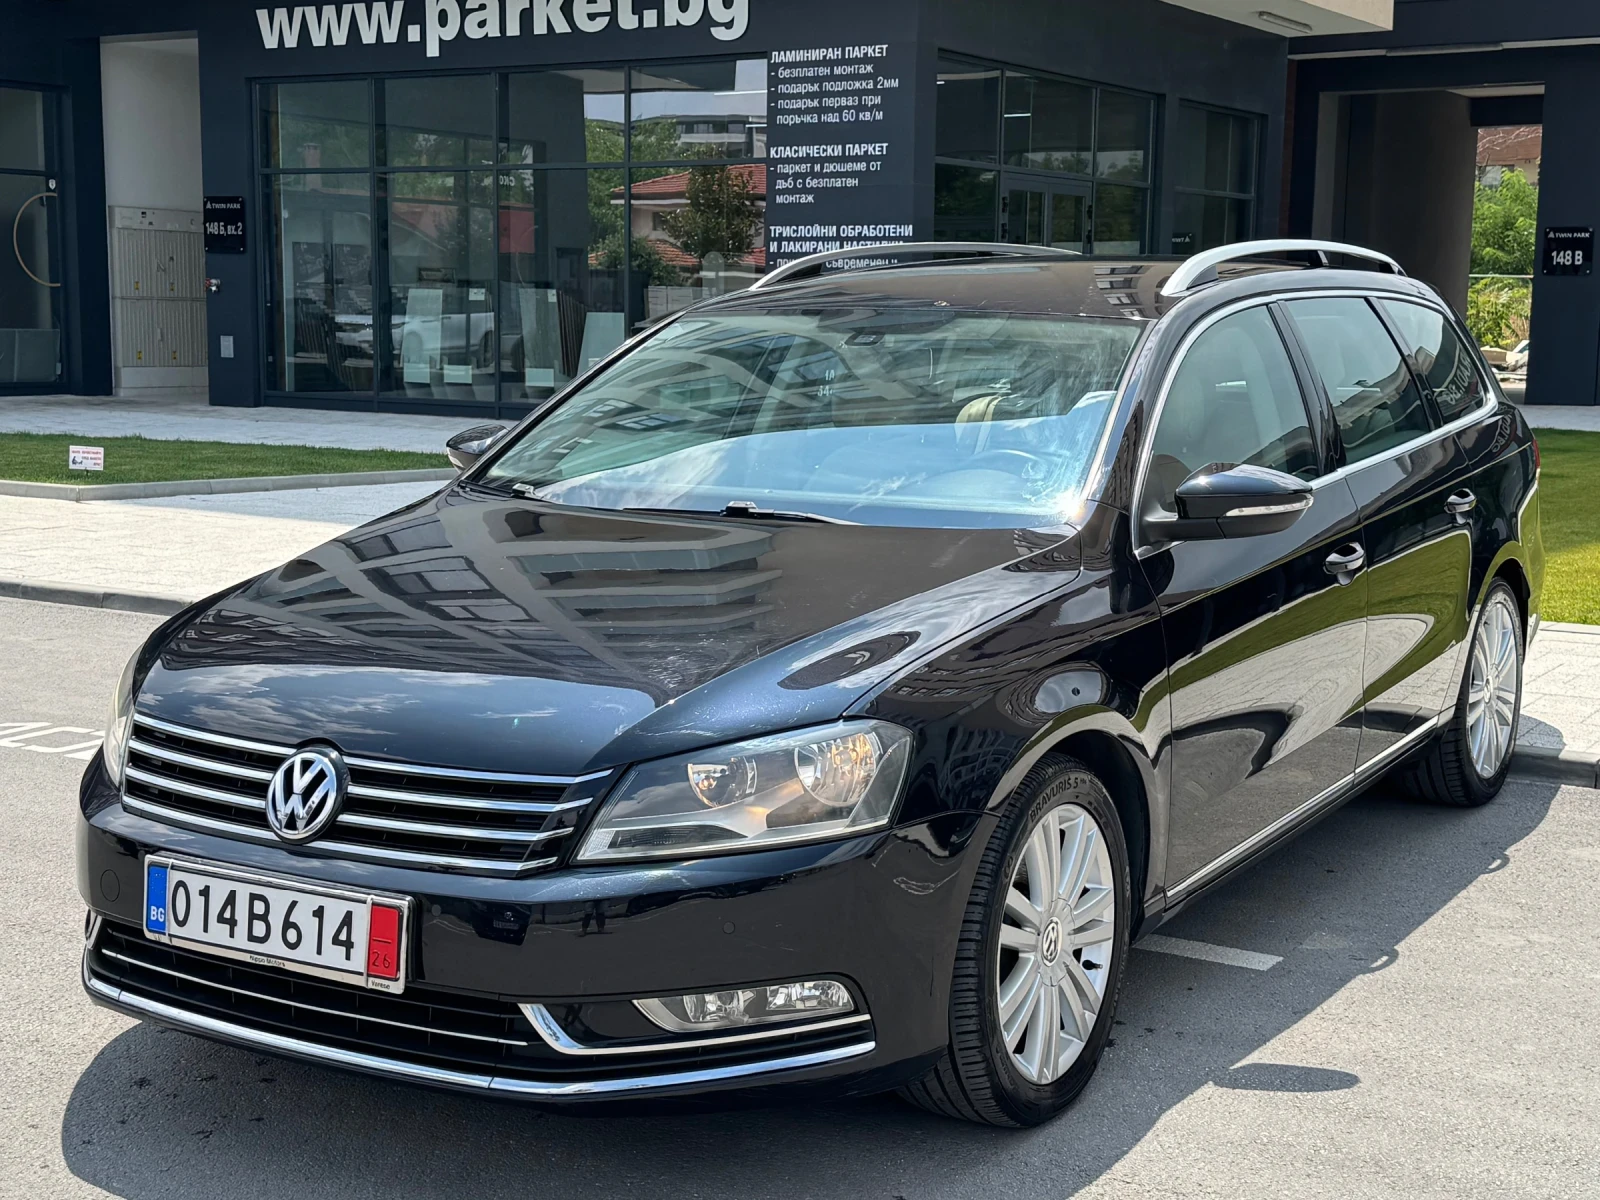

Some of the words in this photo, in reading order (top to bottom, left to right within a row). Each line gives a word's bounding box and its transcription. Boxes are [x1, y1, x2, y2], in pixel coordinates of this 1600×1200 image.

[255, 0, 750, 57] www.parket.bg
[771, 47, 842, 63] ЛАМИНИРАН
[845, 44, 888, 58] ПАРКЕТ
[778, 66, 830, 78] безплатен
[834, 63, 874, 75] монтаж
[778, 82, 820, 94] подарък
[822, 78, 874, 92] подложка
[877, 76, 899, 89] 2мм
[778, 98, 820, 110] подарък
[822, 96, 859, 108] перваз
[862, 95, 881, 106] при
[776, 114, 818, 126] поръчка
[821, 112, 840, 124] над
[842, 110, 856, 122] 60
[859, 109, 884, 122] кв/м
[770, 145, 842, 159] КЛАСИЧЕСКИ
[845, 142, 888, 156] ПАРКЕТ
[777, 162, 811, 174] паркет
[814, 163, 821, 172] и
[823, 162, 867, 173] дюшеме
[870, 161, 882, 171] от
[776, 177, 794, 189] дъб
[796, 179, 803, 188] с
[805, 176, 859, 188] безплатен
[775, 193, 815, 204] монтаж
[769, 224, 837, 238] ТРИСЛОЙНИ
[840, 224, 913, 237] ОБРАБОТЕНИ
[769, 241, 778, 253] И
[780, 241, 840, 253] ЛАКИРАНИ
[1552, 250, 1572, 265] 148
[1029, 777, 1072, 822] BRAVURIS
[150, 905, 165, 922] BG
[371, 950, 391, 969] 26
